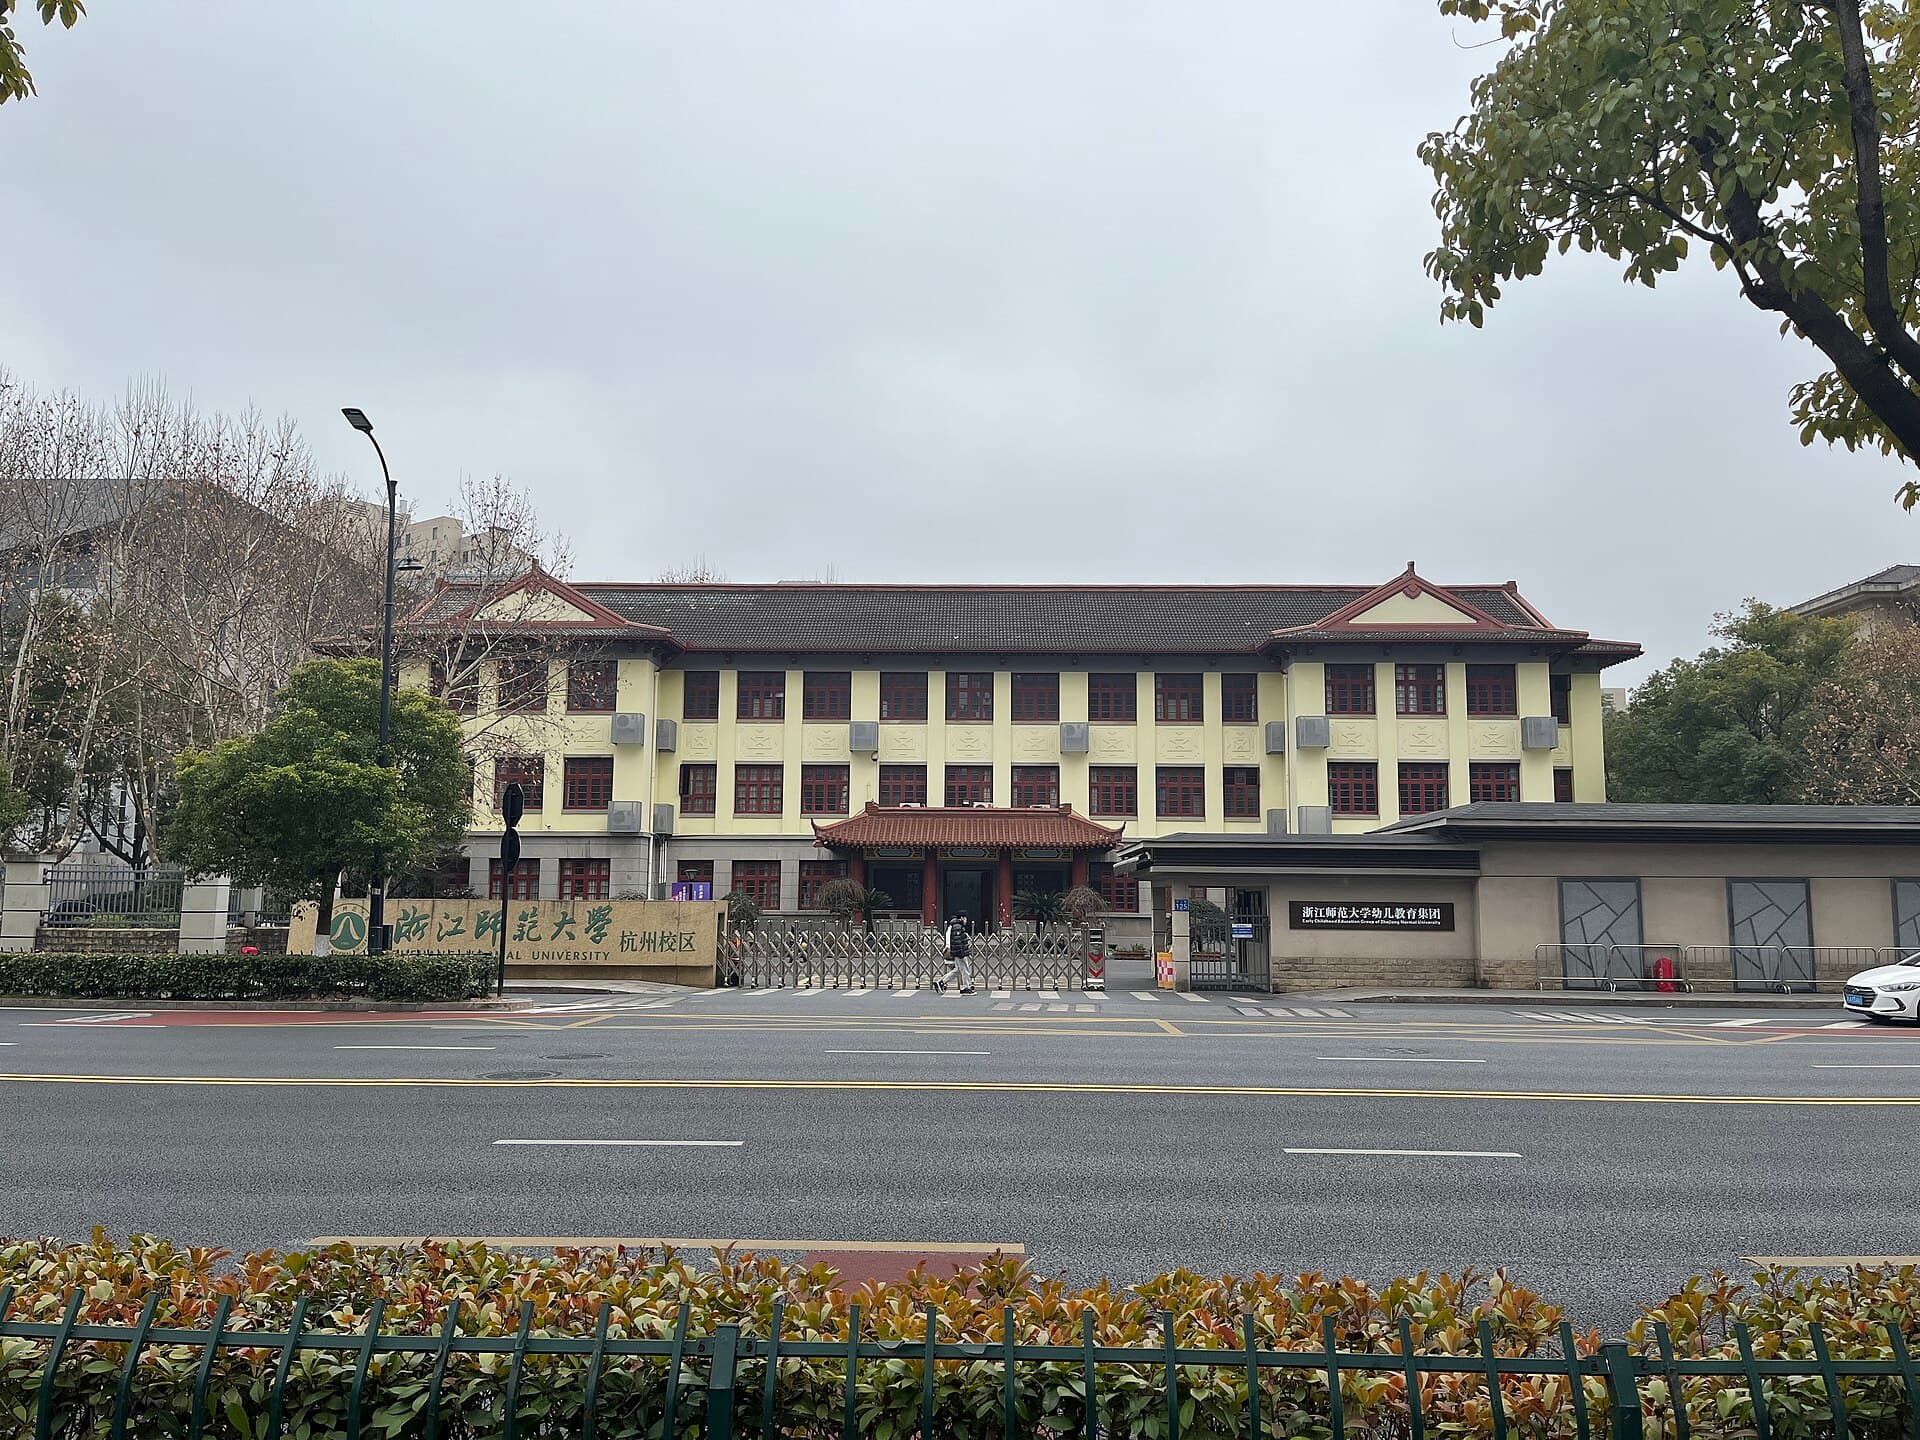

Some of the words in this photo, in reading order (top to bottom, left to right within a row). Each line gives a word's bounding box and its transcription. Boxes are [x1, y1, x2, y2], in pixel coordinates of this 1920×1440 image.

[1302, 906, 1440, 919] 浙江师范大学幼儿教育集团
[620, 930, 696, 953] 杭州校区
[532, 951, 610, 961] UNIVERSITY
